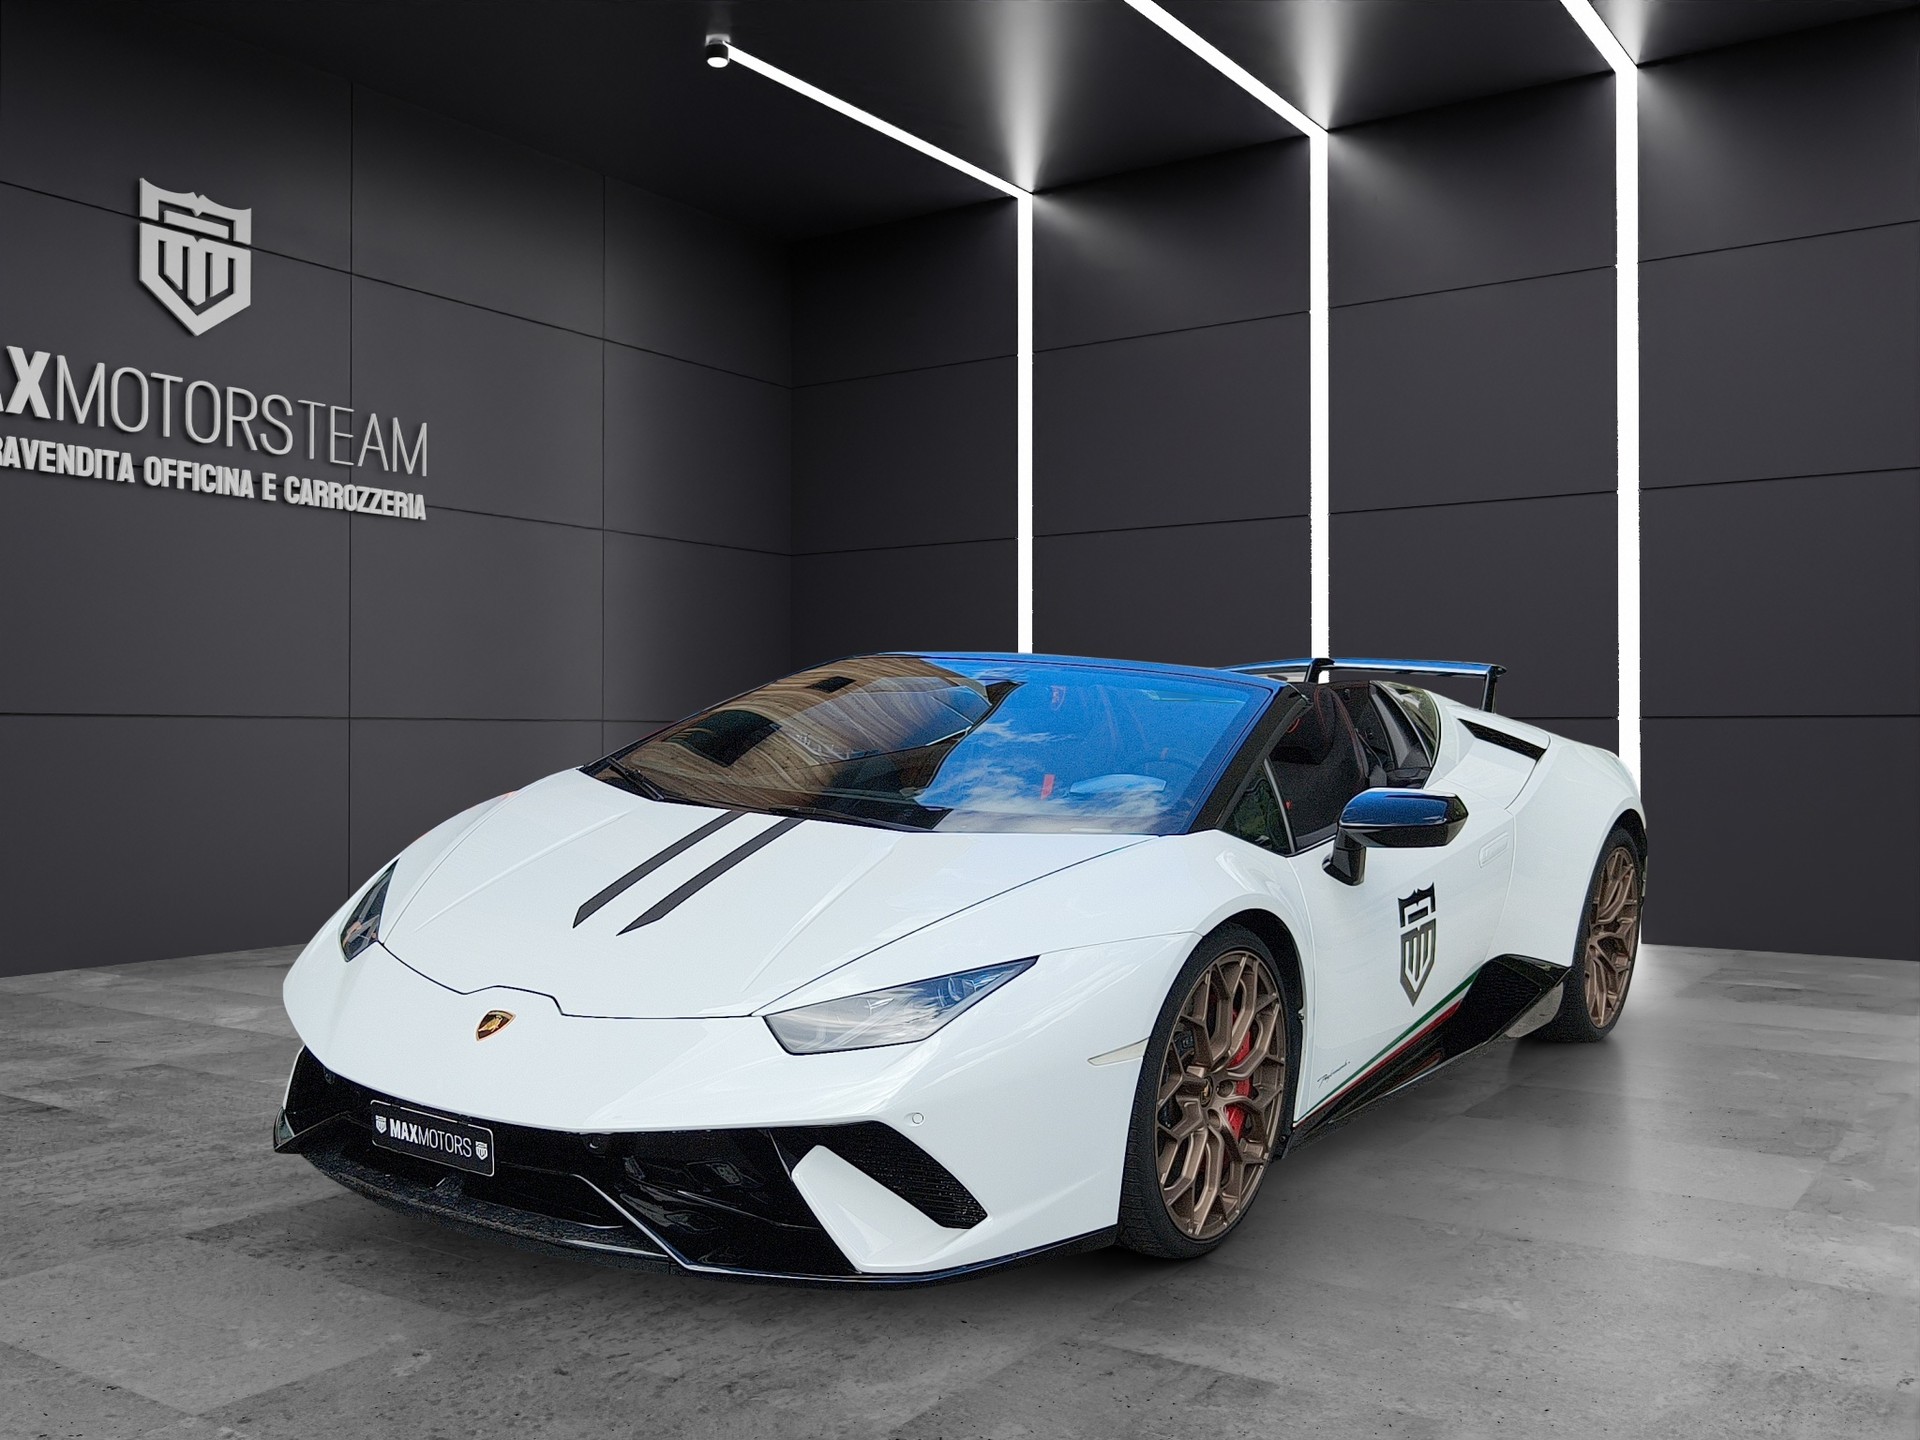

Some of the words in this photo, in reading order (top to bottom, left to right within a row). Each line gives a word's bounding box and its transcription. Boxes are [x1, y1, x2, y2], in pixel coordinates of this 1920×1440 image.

[0, 345, 428, 477] XMOTORSTEAM
[143, 456, 254, 499] OFFICINA
[262, 472, 277, 501] E
[283, 475, 427, 521] CARROZZERIA
[389, 1117, 473, 1158] MAXMOTORS
